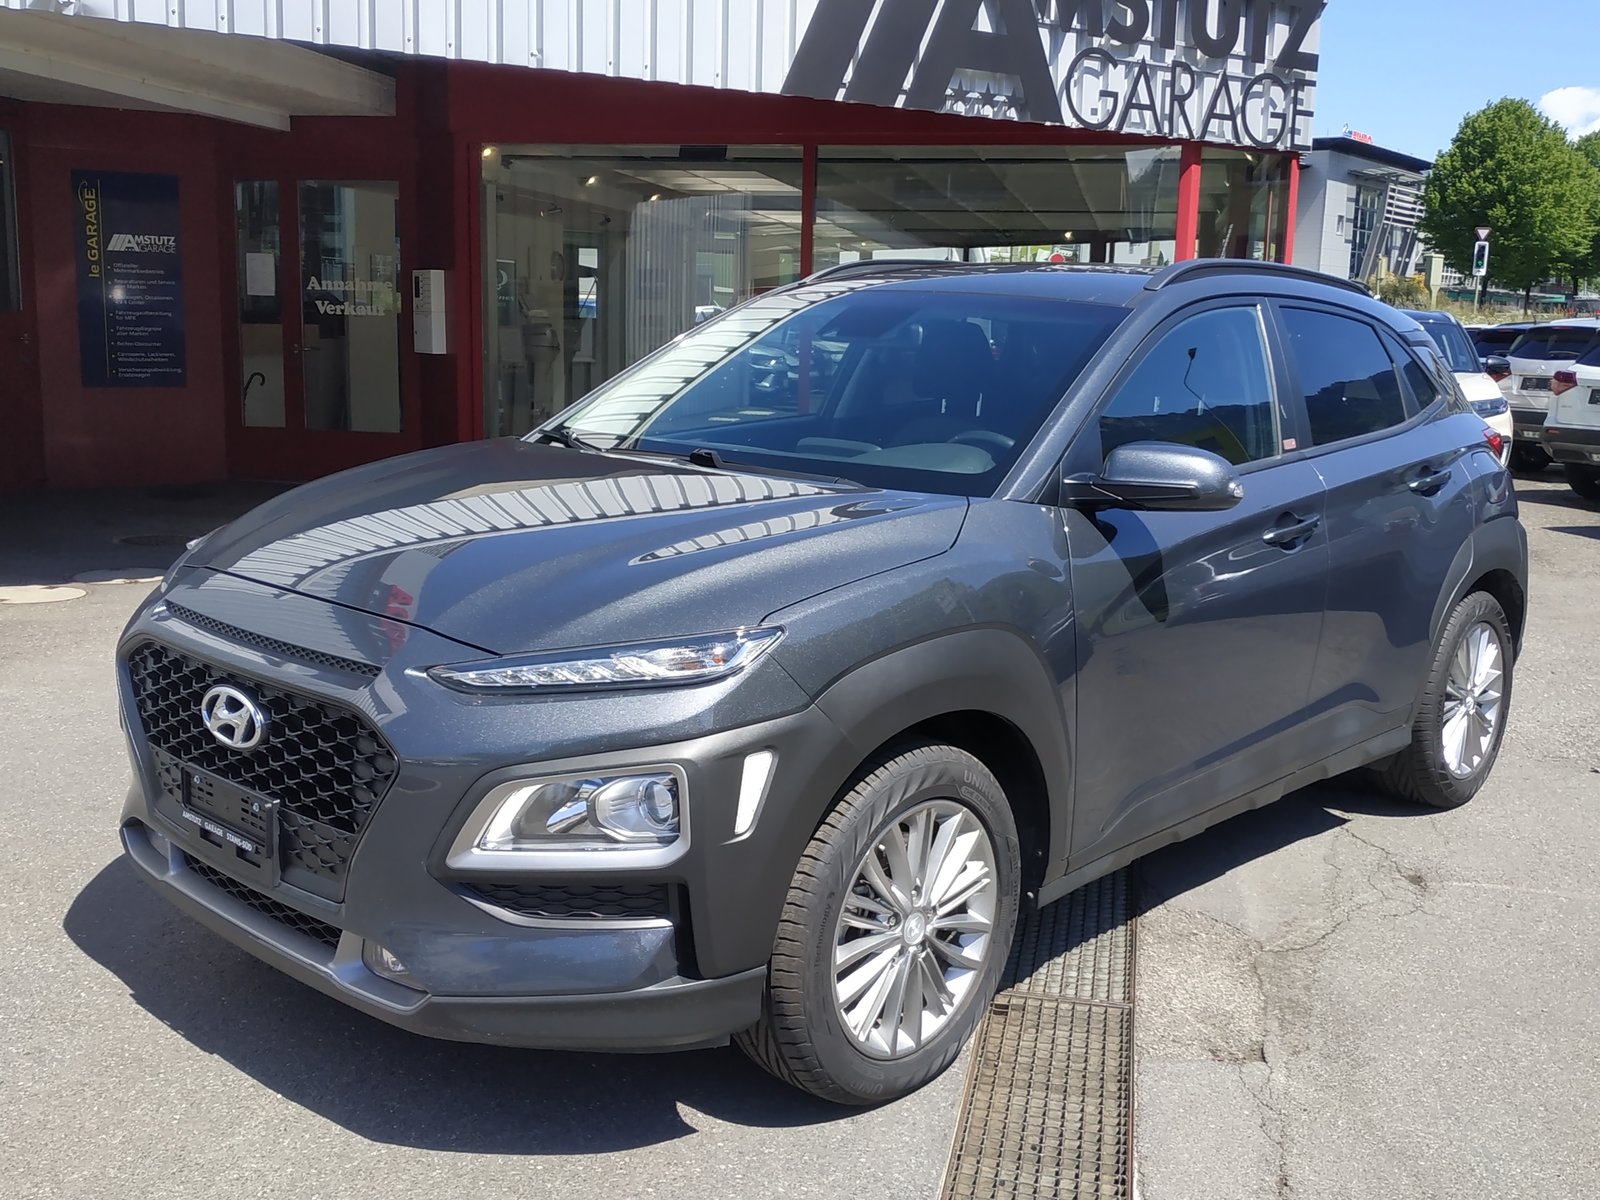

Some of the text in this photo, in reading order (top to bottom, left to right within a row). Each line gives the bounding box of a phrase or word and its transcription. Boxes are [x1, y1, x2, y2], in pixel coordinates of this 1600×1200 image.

[1064, 47, 1317, 151] GARAGE
[84, 188, 98, 261] GARAGE
[116, 234, 176, 250] AMSTUTZ
[138, 243, 176, 254] GARAGE
[306, 275, 393, 291] Annahme
[315, 300, 385, 316] Verkauf
[204, 822, 223, 838] GARAGE
